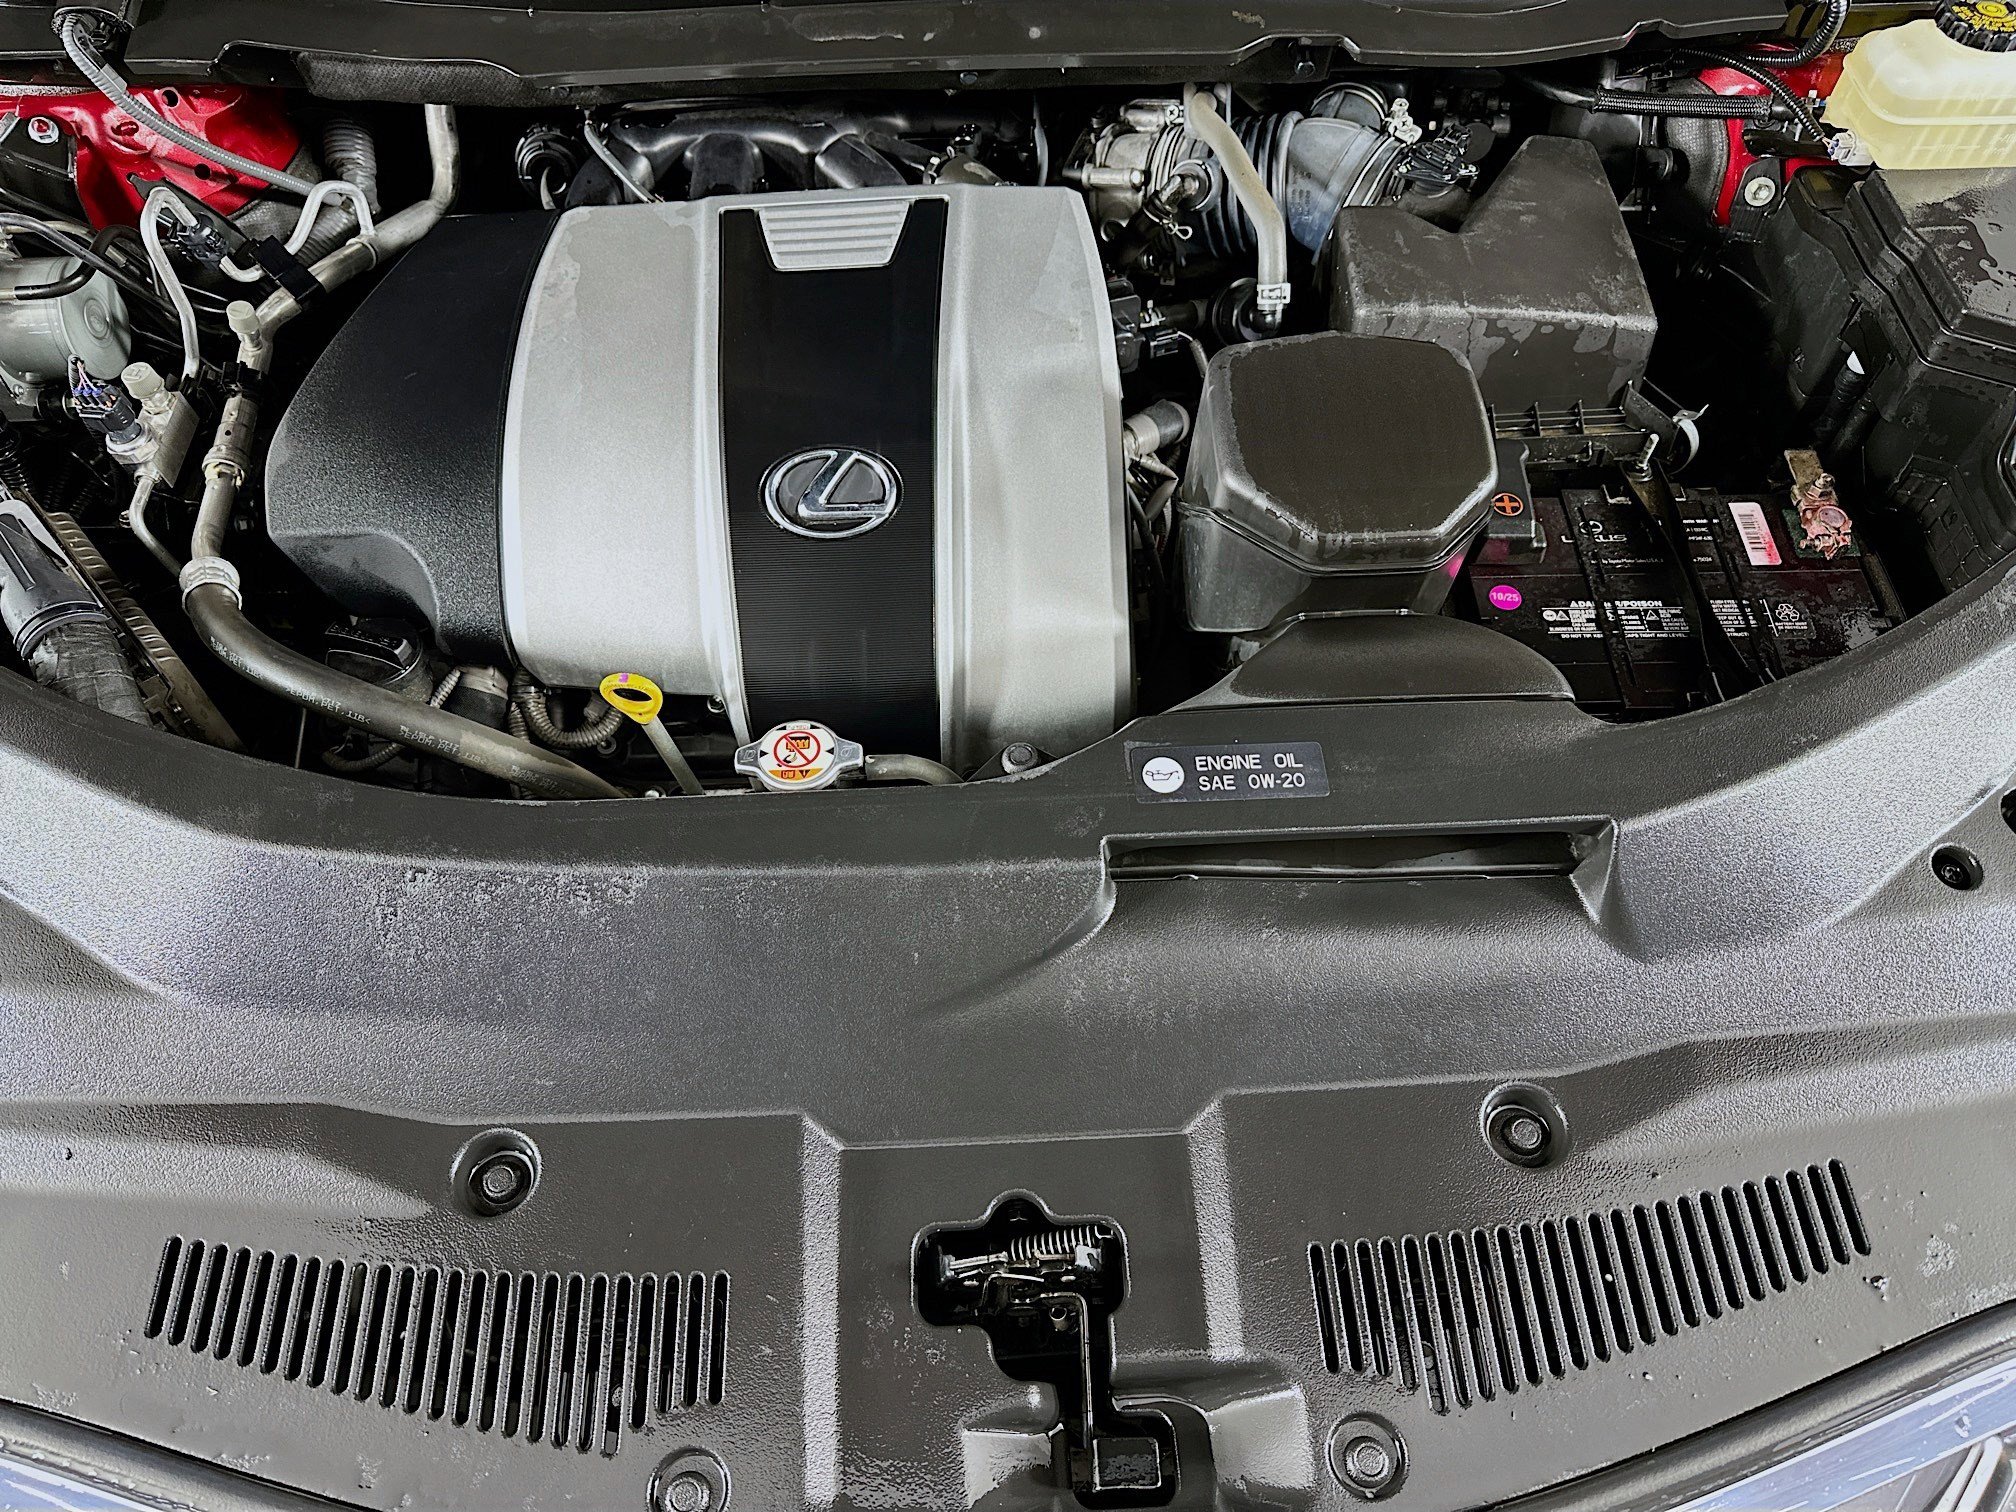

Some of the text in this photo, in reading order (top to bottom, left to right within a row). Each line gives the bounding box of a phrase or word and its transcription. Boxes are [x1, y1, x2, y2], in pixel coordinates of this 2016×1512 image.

[1491, 592, 1519, 602] 10/25
[1195, 753, 1303, 771] ENGINE OIL
[1199, 772, 1306, 791] SAE 0W-20
